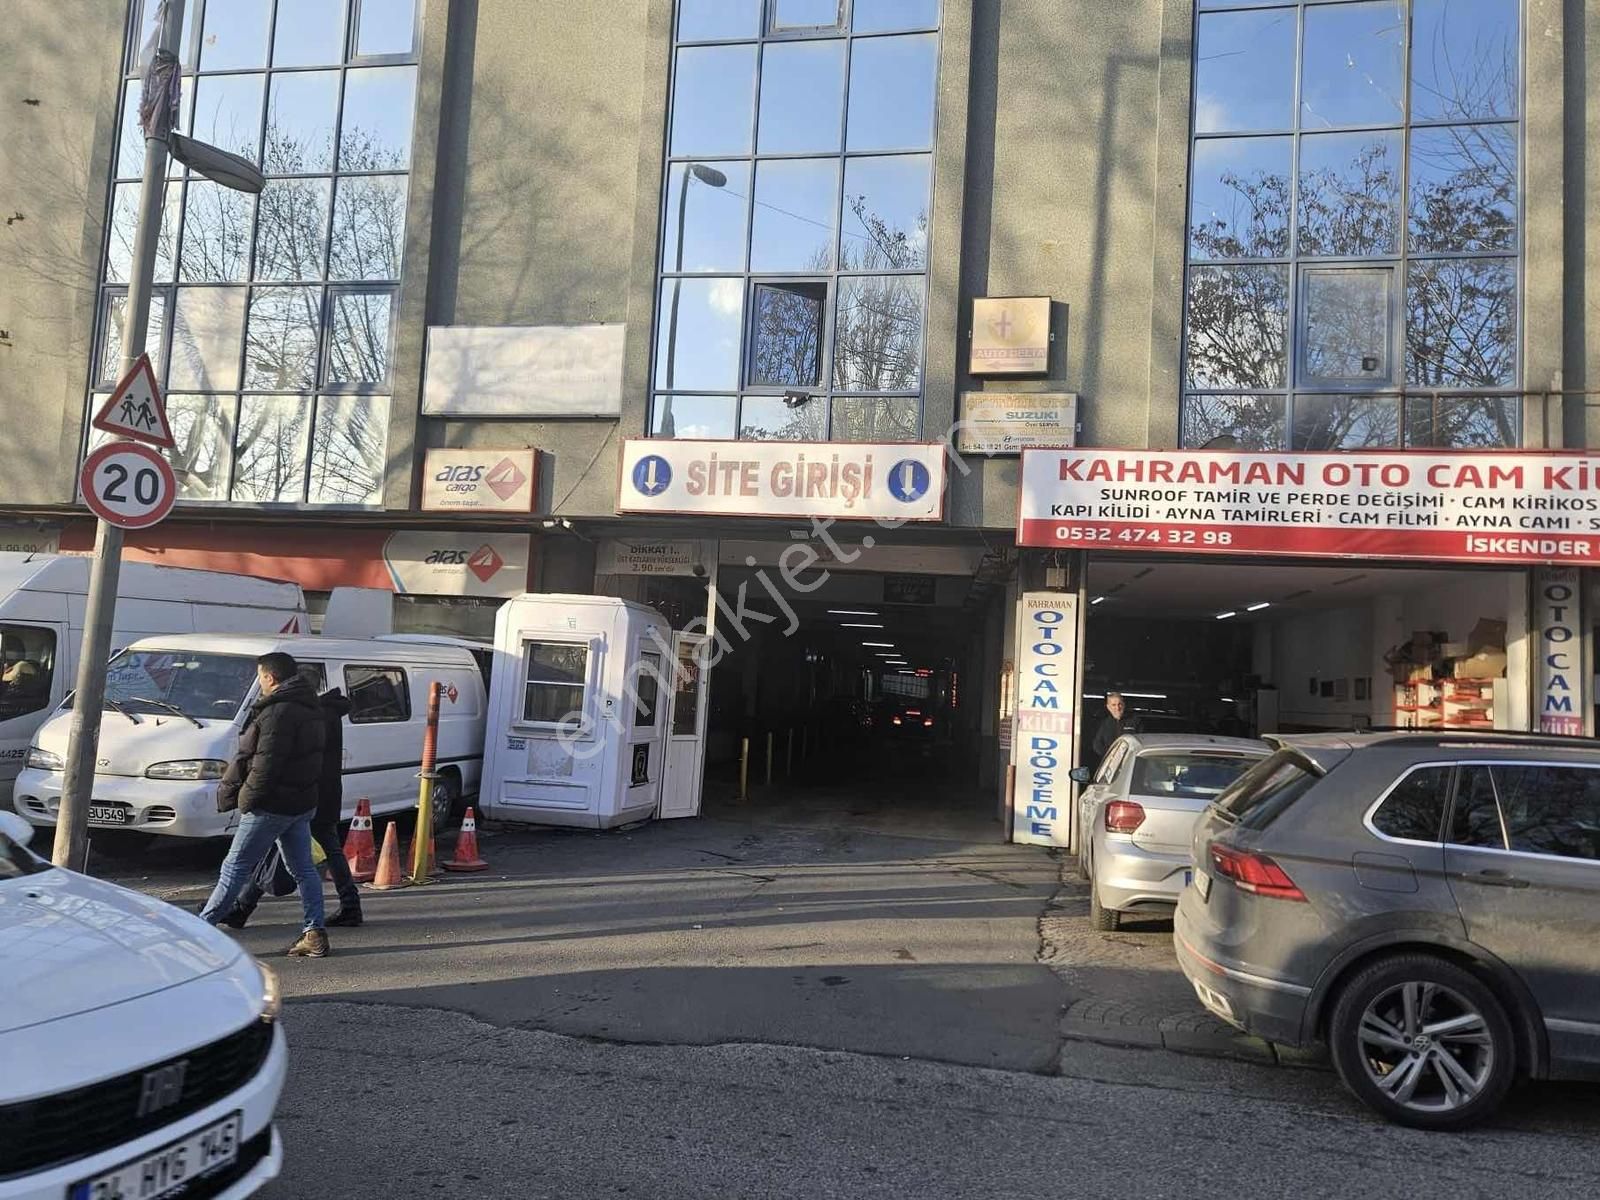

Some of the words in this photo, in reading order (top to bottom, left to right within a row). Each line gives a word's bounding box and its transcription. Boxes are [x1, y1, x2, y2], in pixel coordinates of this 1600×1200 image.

[1005, 411, 1058, 420] SUZUKI
[102, 463, 159, 505] 20
[435, 465, 485, 482] aras
[686, 452, 761, 496] SİTE
[770, 453, 874, 508] GİRİŞİ
[1058, 458, 1306, 486] KAHRAMAN
[1322, 463, 1411, 487] OTO
[1426, 464, 1524, 490] CAM
[445, 483, 477, 494] cargo
[1100, 488, 1188, 502] SUNROOF
[1194, 489, 1251, 504] TAMİR
[1257, 492, 1281, 505] VE
[1287, 493, 1351, 506] PERDE
[1357, 491, 1444, 510] DEĞİŞİMİ
[1462, 496, 1505, 509] CAM
[1512, 495, 1598, 511] KİRİKOS
[1050, 504, 1092, 517] KAPI
[1098, 503, 1150, 519] KİLİDİ
[1165, 507, 1216, 521] AYNA
[1222, 507, 1321, 523] TAMİRLERİ
[1338, 512, 1379, 525] CAM
[1387, 510, 1438, 526] FİLMİ
[1456, 515, 1512, 528] AYNA
[1519, 516, 1570, 529] CAMI
[1055, 526, 1111, 541] 0532
[1117, 528, 1161, 543] 474
[1168, 529, 1196, 544] 32
[1202, 531, 1233, 545] 98
[1465, 534, 1591, 556] İSKENDER
[424, 550, 469, 565] aras
[1027, 599, 1072, 609] KAHRAMAN
[1543, 585, 1573, 643] OTO
[1031, 610, 1064, 656] OTO
[1031, 663, 1059, 709] CAM
[1545, 653, 1573, 712] CAM
[1021, 713, 1069, 732] KİLİT
